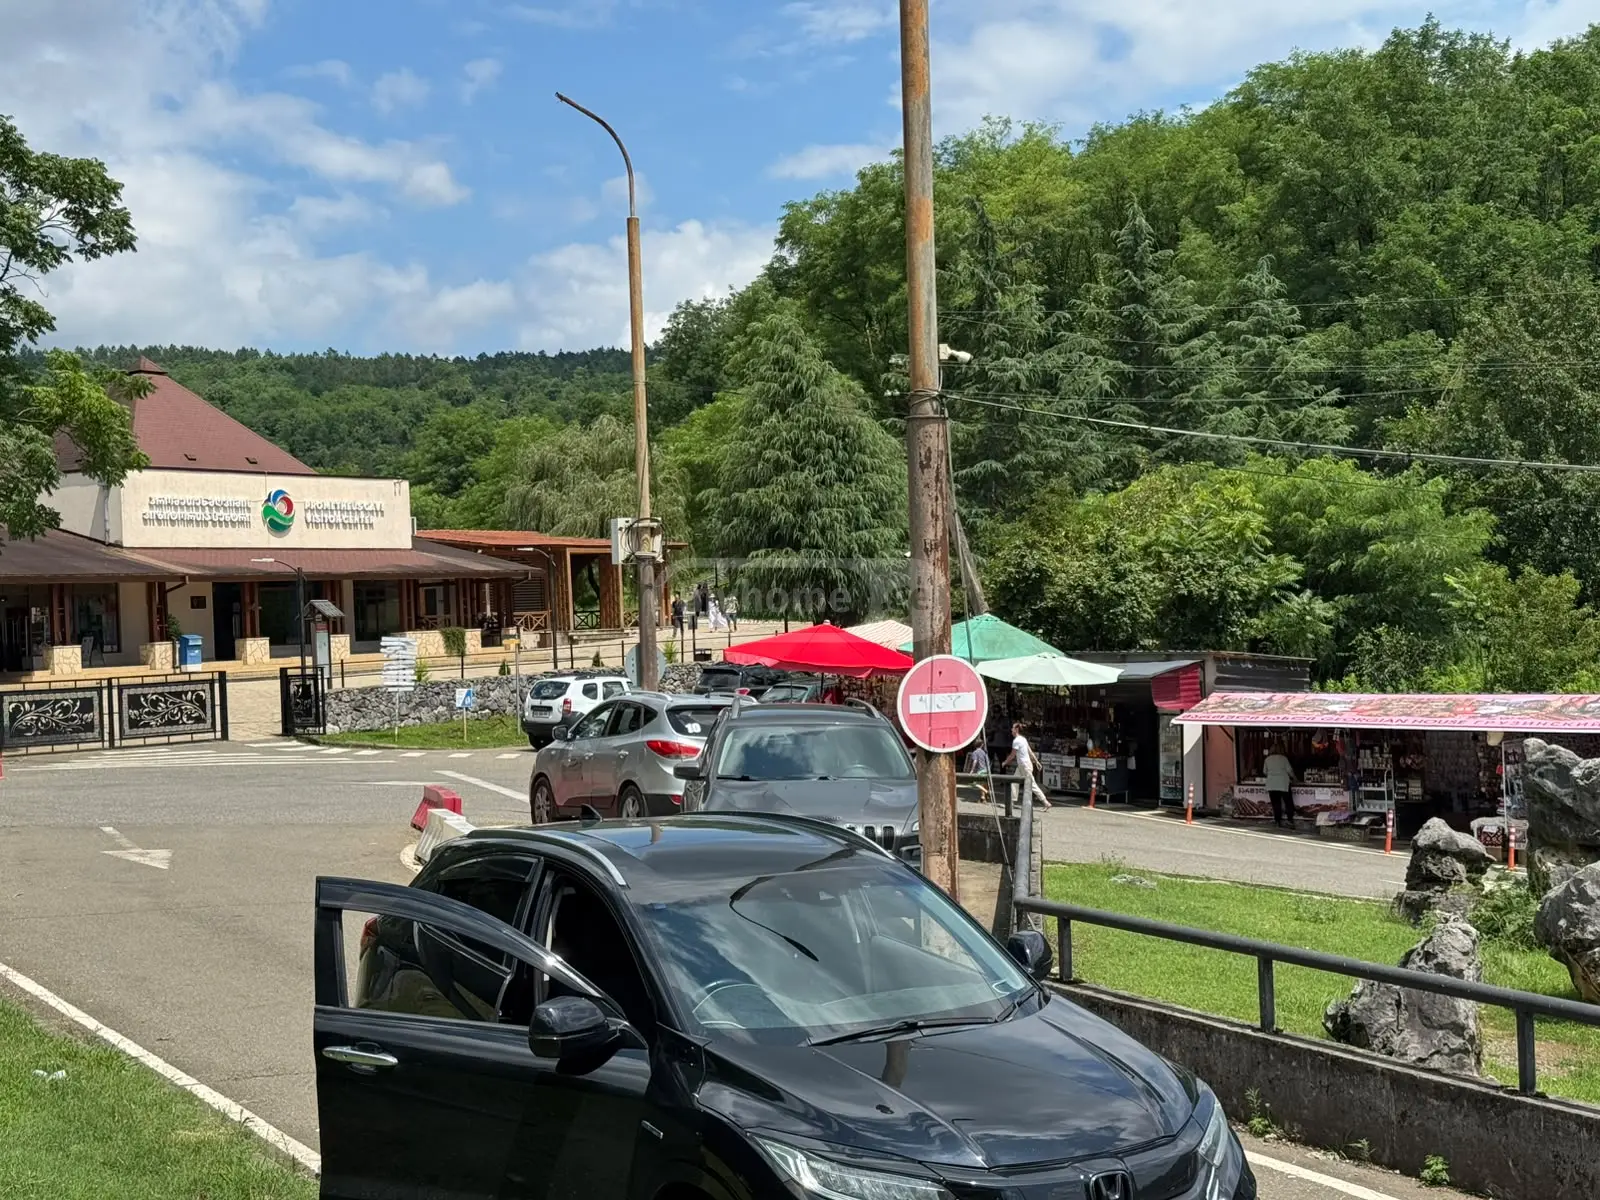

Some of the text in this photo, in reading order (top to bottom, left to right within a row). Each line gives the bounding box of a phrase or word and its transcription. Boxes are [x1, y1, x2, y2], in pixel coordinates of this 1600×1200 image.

[304, 500, 362, 512] PROMETHEUS
[305, 512, 374, 525] VISITOR CENTER
[1321, 716, 1407, 724] GEORGIAN
[685, 722, 702, 734] 10
